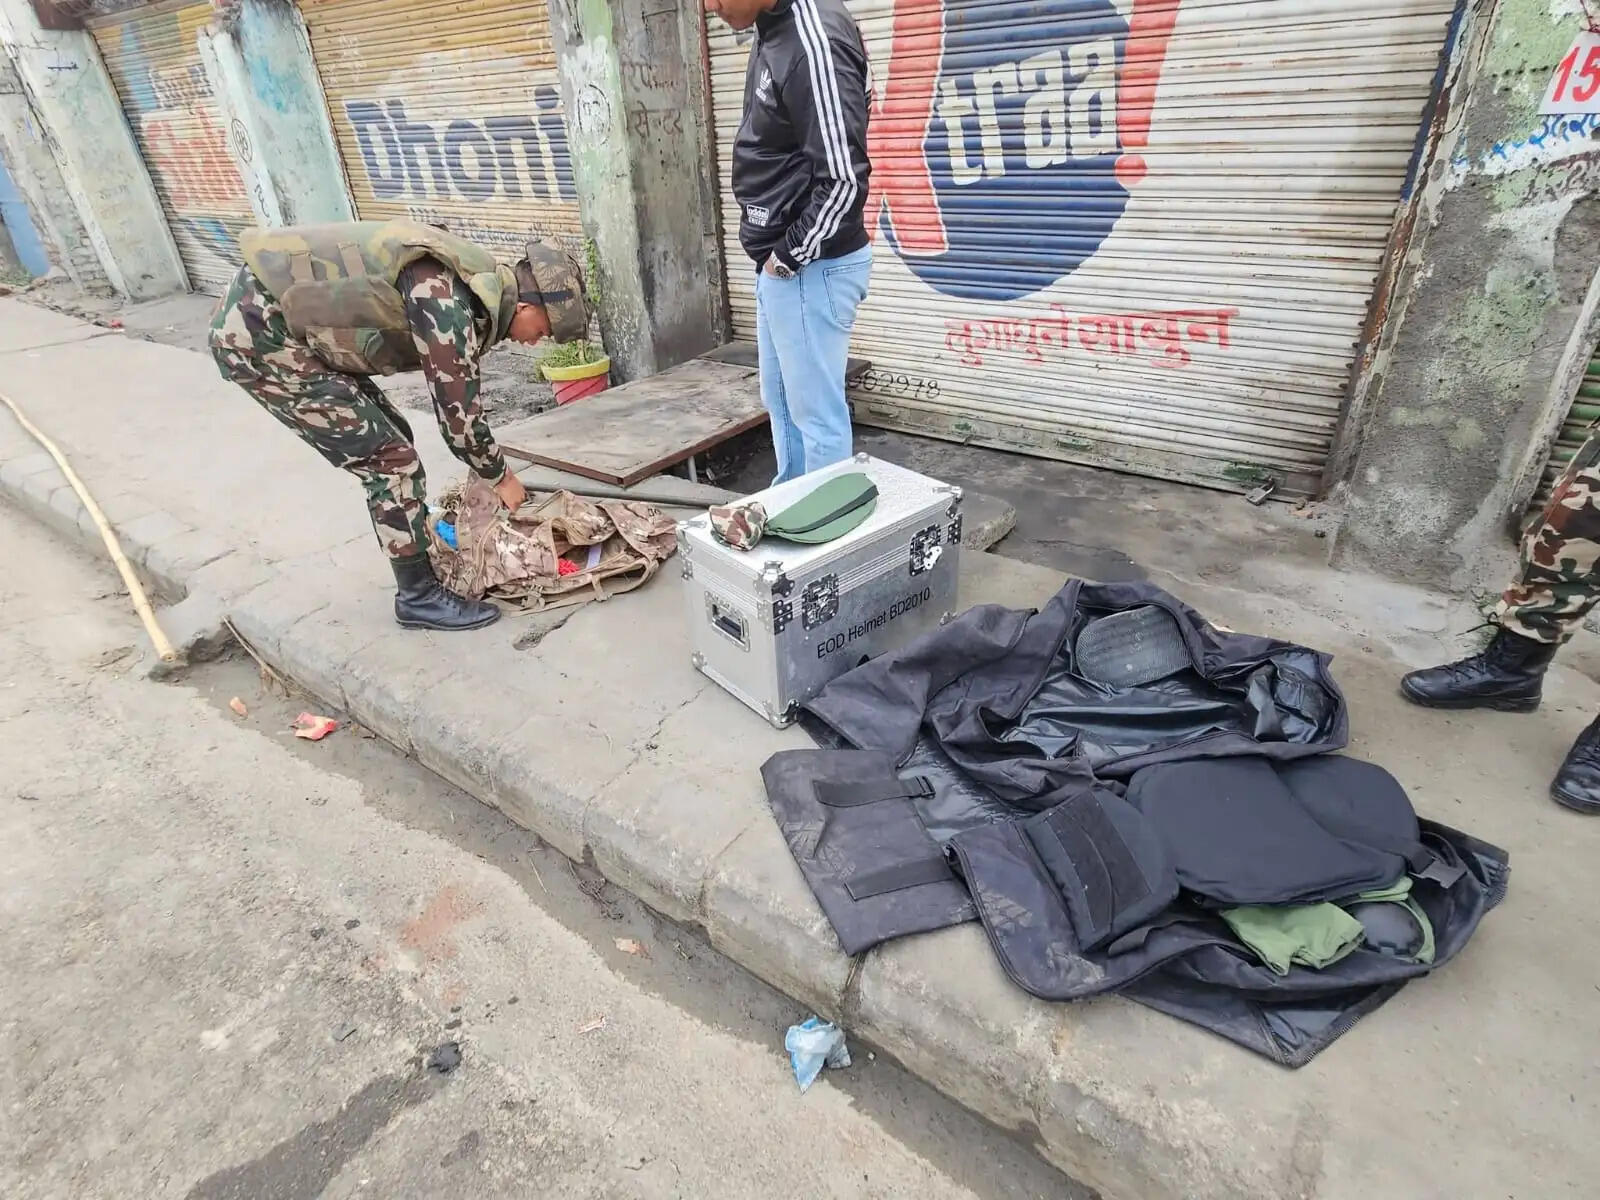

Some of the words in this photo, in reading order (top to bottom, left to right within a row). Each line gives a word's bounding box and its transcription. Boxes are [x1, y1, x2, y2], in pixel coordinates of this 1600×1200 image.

[816, 632, 845, 660] EOD
[847, 611, 887, 642] Helmet
[889, 586, 931, 621] BD2010
